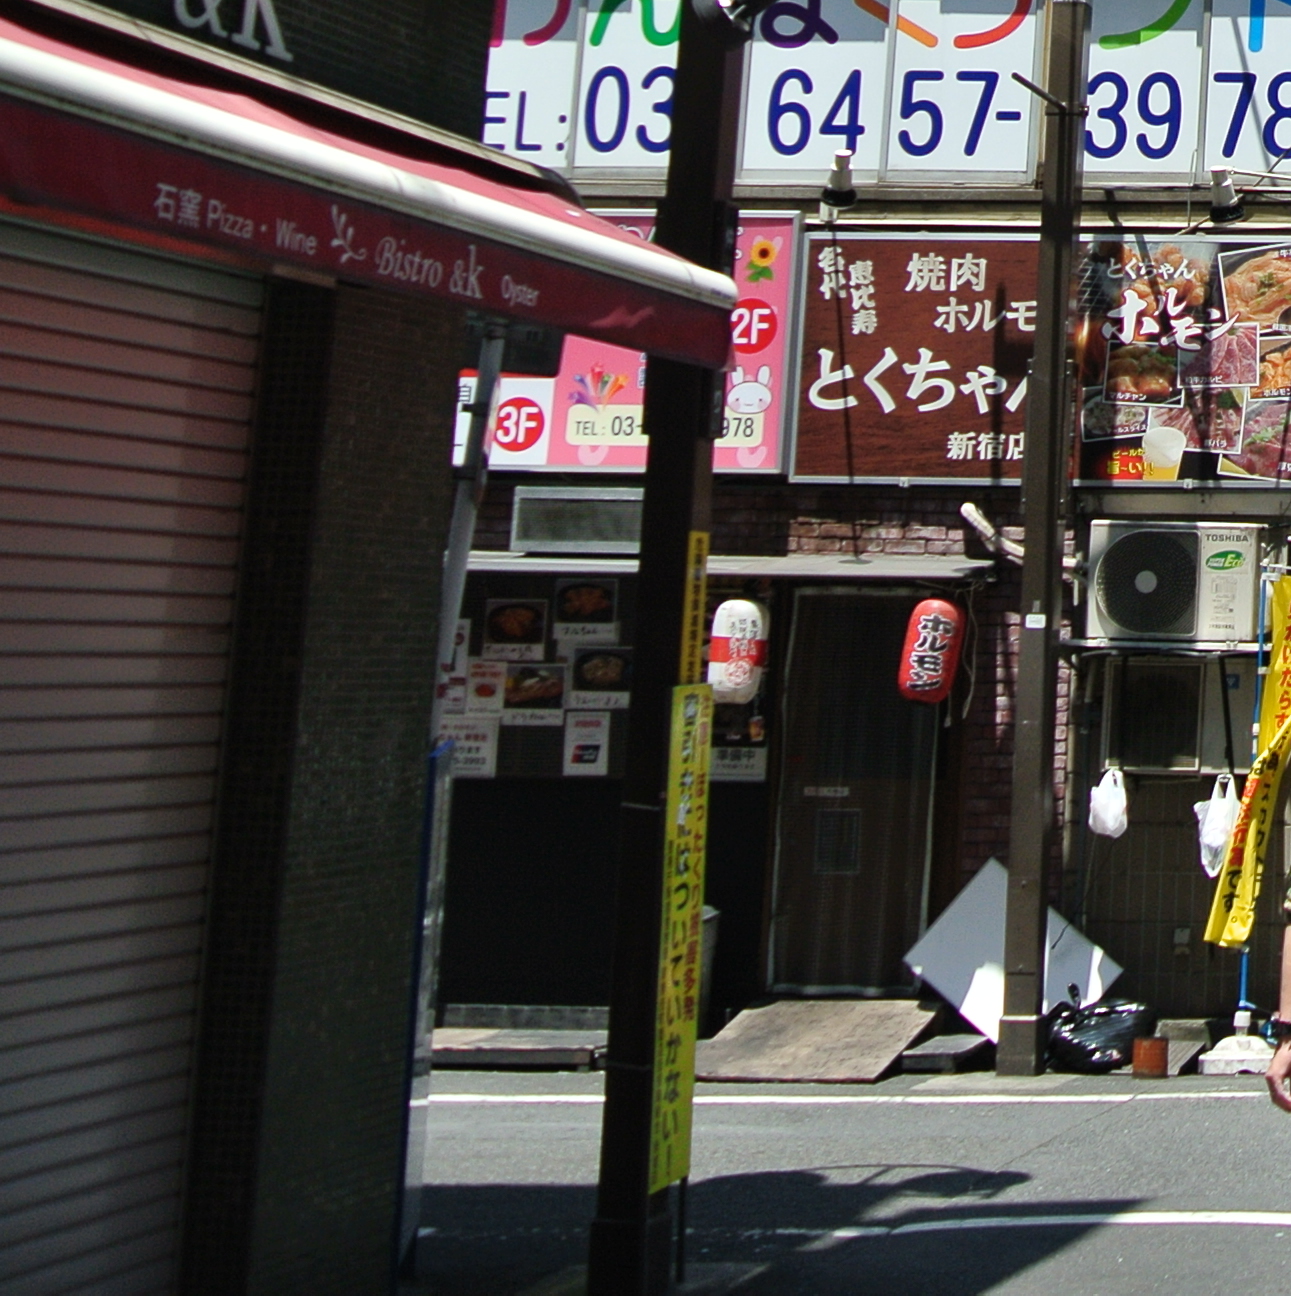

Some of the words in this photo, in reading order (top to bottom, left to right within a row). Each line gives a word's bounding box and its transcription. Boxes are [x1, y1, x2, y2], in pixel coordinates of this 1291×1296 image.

[205, 198, 256, 239] Pizza
[274, 218, 318, 255] Wine
[375, 234, 444, 289] Bistro
[448, 244, 486, 300] &k
[904, 252, 988, 292] 焼肉
[1106, 257, 1196, 281] とくちゃん
[848, 260, 878, 335] 恵比寿
[1101, 286, 1241, 351] ホルモン
[731, 308, 771, 345] 2F
[496, 406, 539, 444] 3F
[1205, 533, 1249, 543] TOSHIBA
[911, 613, 956, 693] ホルモン
